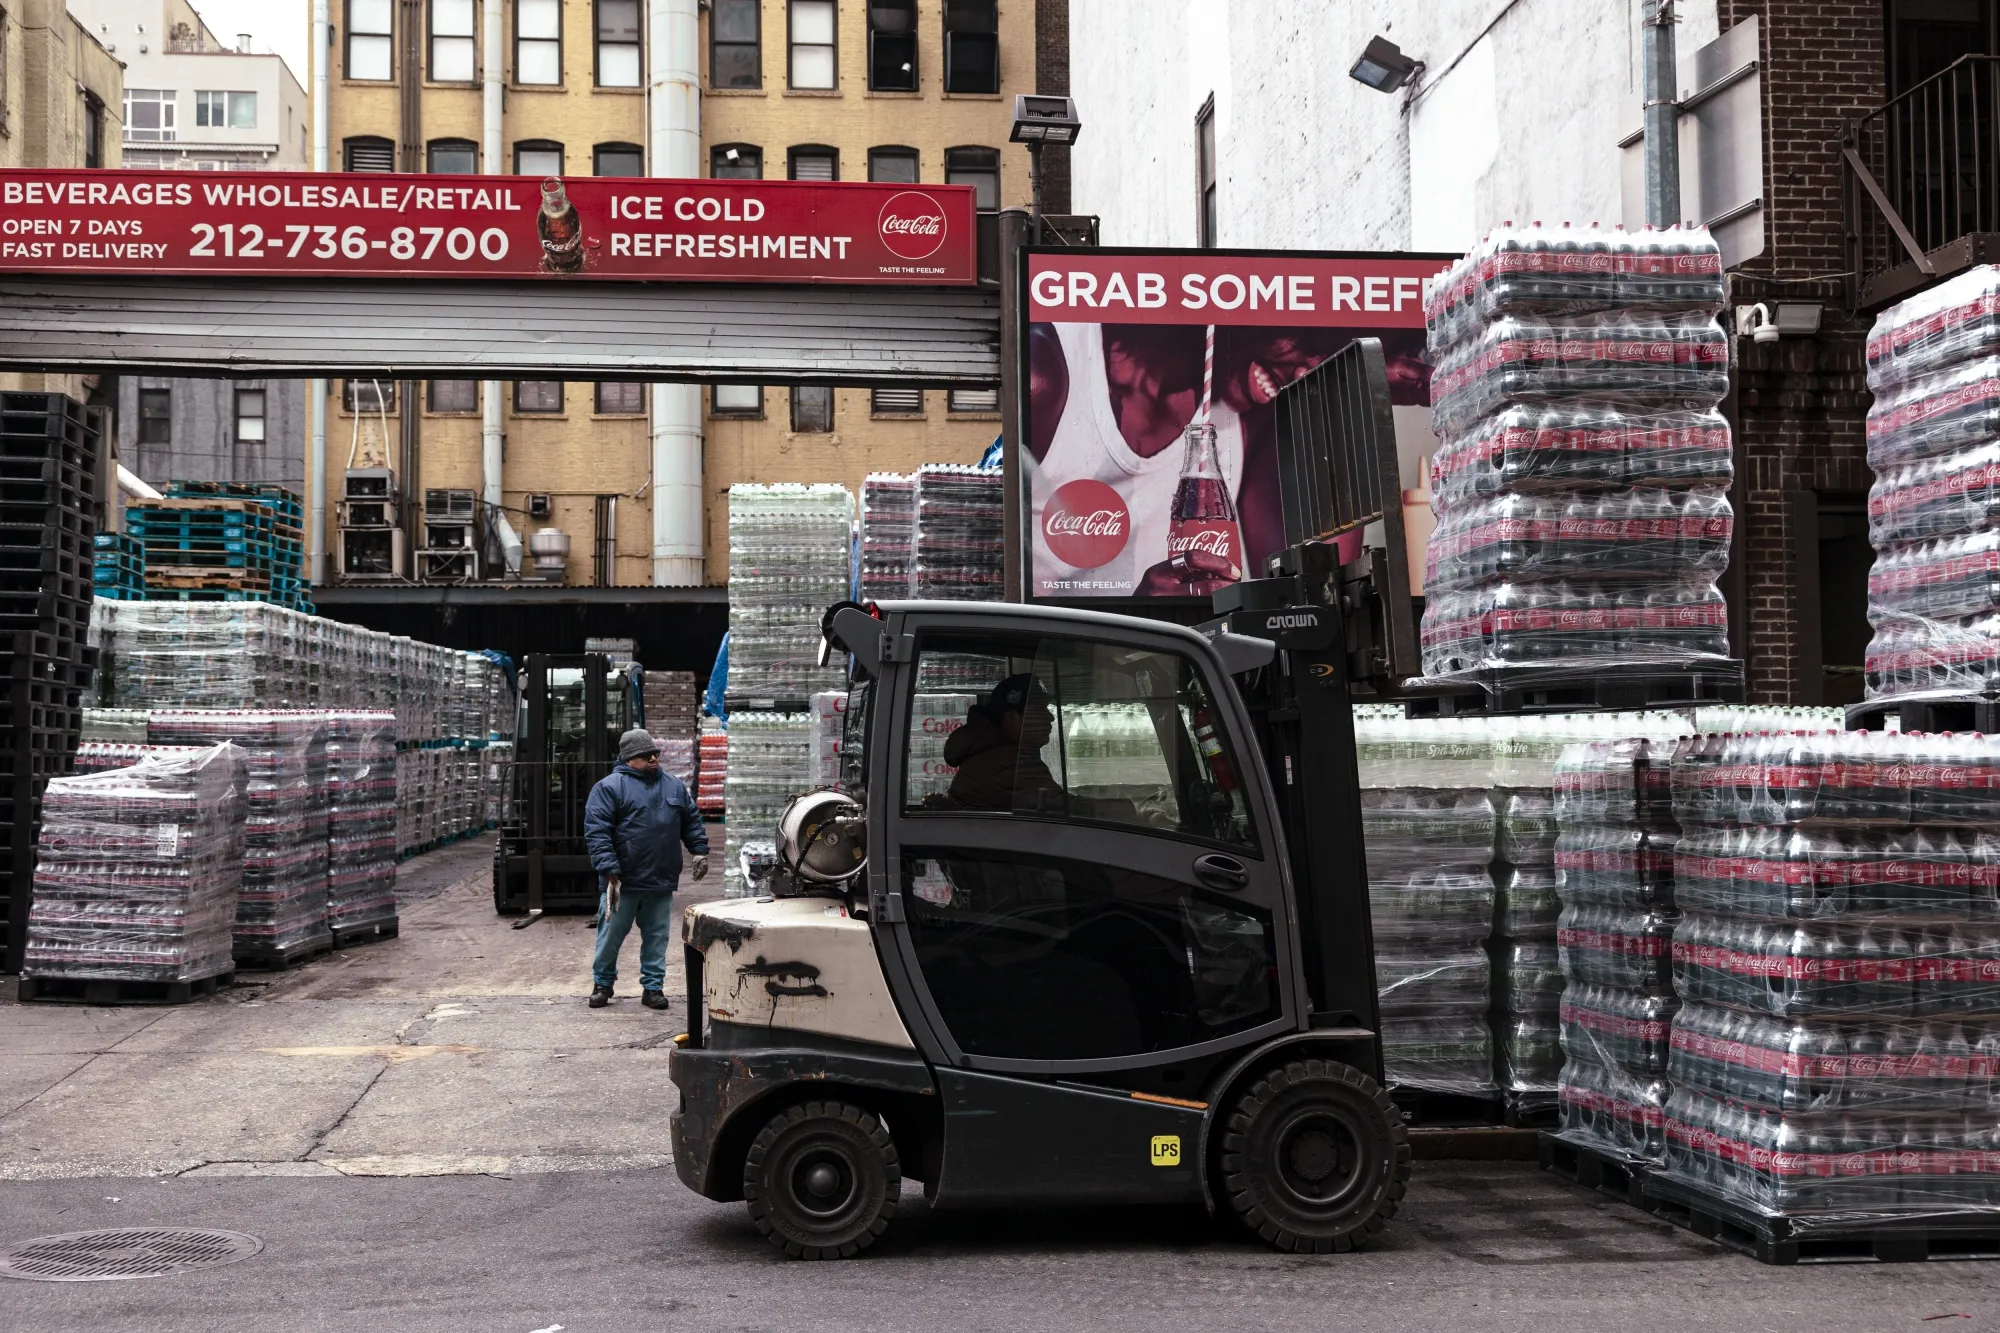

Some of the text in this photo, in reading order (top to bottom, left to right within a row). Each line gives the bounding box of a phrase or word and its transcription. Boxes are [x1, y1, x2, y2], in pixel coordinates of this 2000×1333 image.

[3, 182, 521, 212] BEVERAGES WHOLESALE/RETAIL
[611, 196, 765, 222] ICE COLD
[2, 220, 143, 236] OPEN 7 DAYS
[882, 214, 942, 235] Coca-Cola
[2, 243, 168, 259] FAST DELIVERY
[189, 223, 509, 261] 212-736-8700
[611, 233, 852, 259] REFRESHMENT
[1031, 270, 1167, 308] GRAB
[1181, 273, 1315, 311] SOME
[1046, 510, 1126, 536] Coca-Cola
[1042, 581, 1131, 589] TASTE THE FEELING
[1153, 1143, 1178, 1157] LPS
